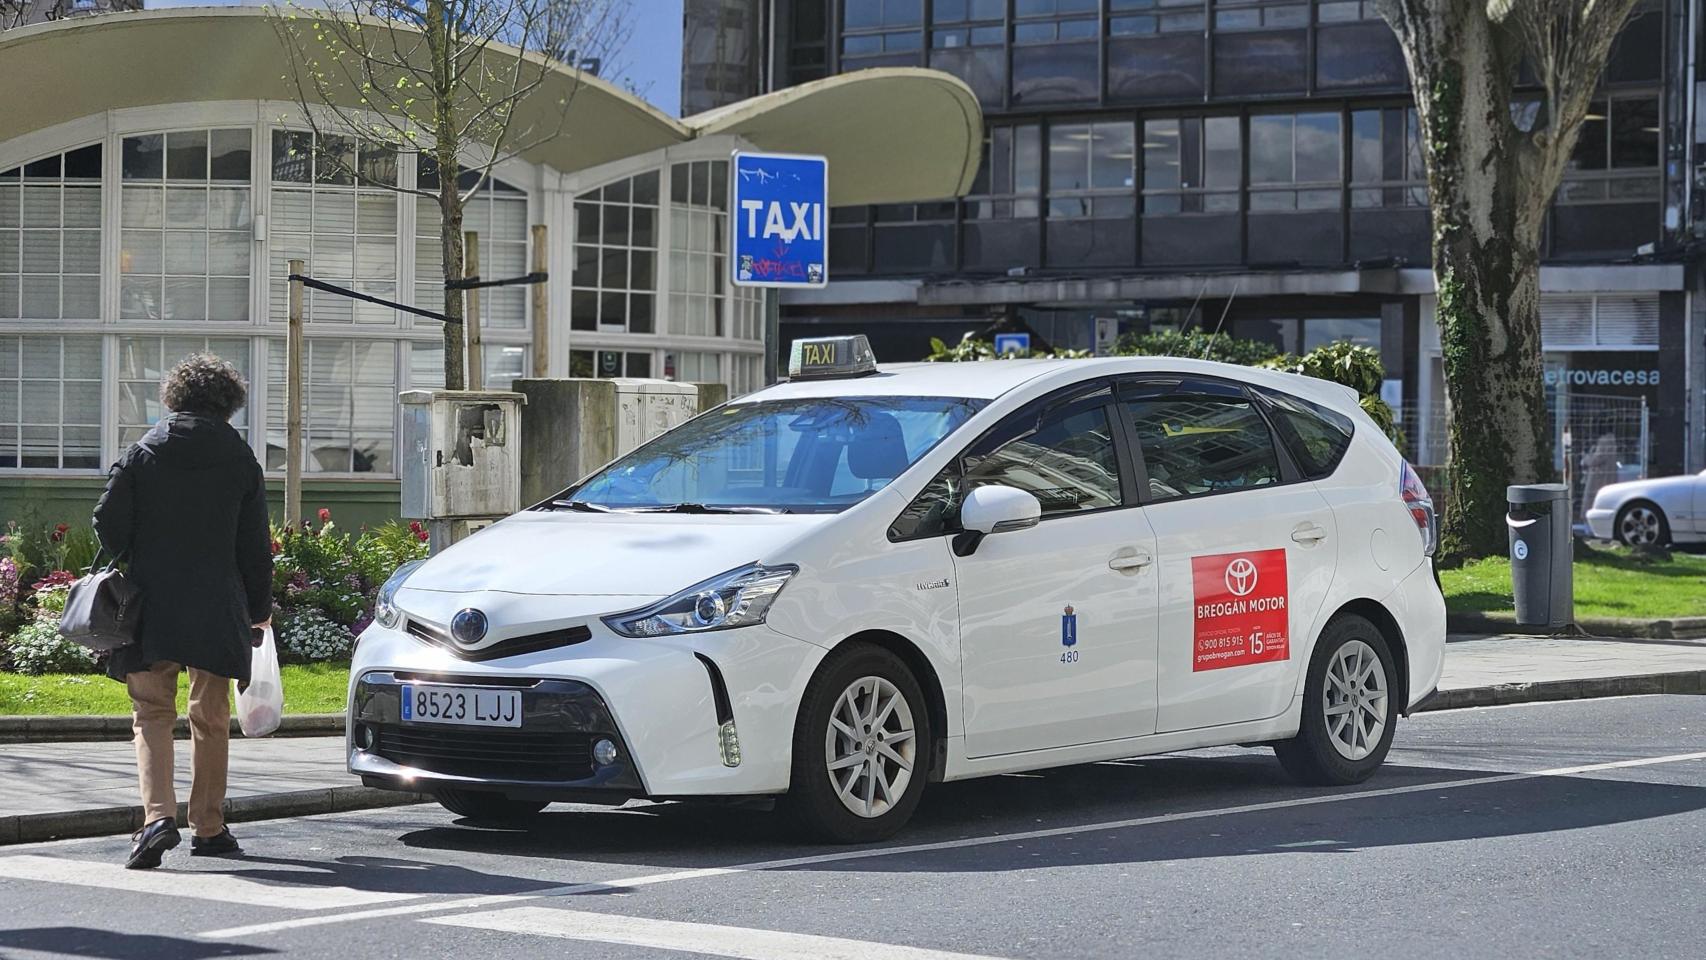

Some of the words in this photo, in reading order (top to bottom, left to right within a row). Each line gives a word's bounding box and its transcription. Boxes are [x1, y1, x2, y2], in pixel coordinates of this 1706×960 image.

[741, 200, 820, 241] TAXI
[804, 343, 835, 365] TAXI
[1545, 368, 1660, 385] etrovacesa
[1197, 599, 1246, 618] BREOGÁN
[1249, 597, 1285, 612] MOTOR
[1204, 639, 1217, 649] 900
[1218, 637, 1231, 648] 815
[1231, 635, 1244, 646] 915
[1248, 632, 1263, 655] 15
[1060, 650, 1079, 664] 480
[417, 691, 466, 720] 8523
[475, 694, 515, 722] LJJ
